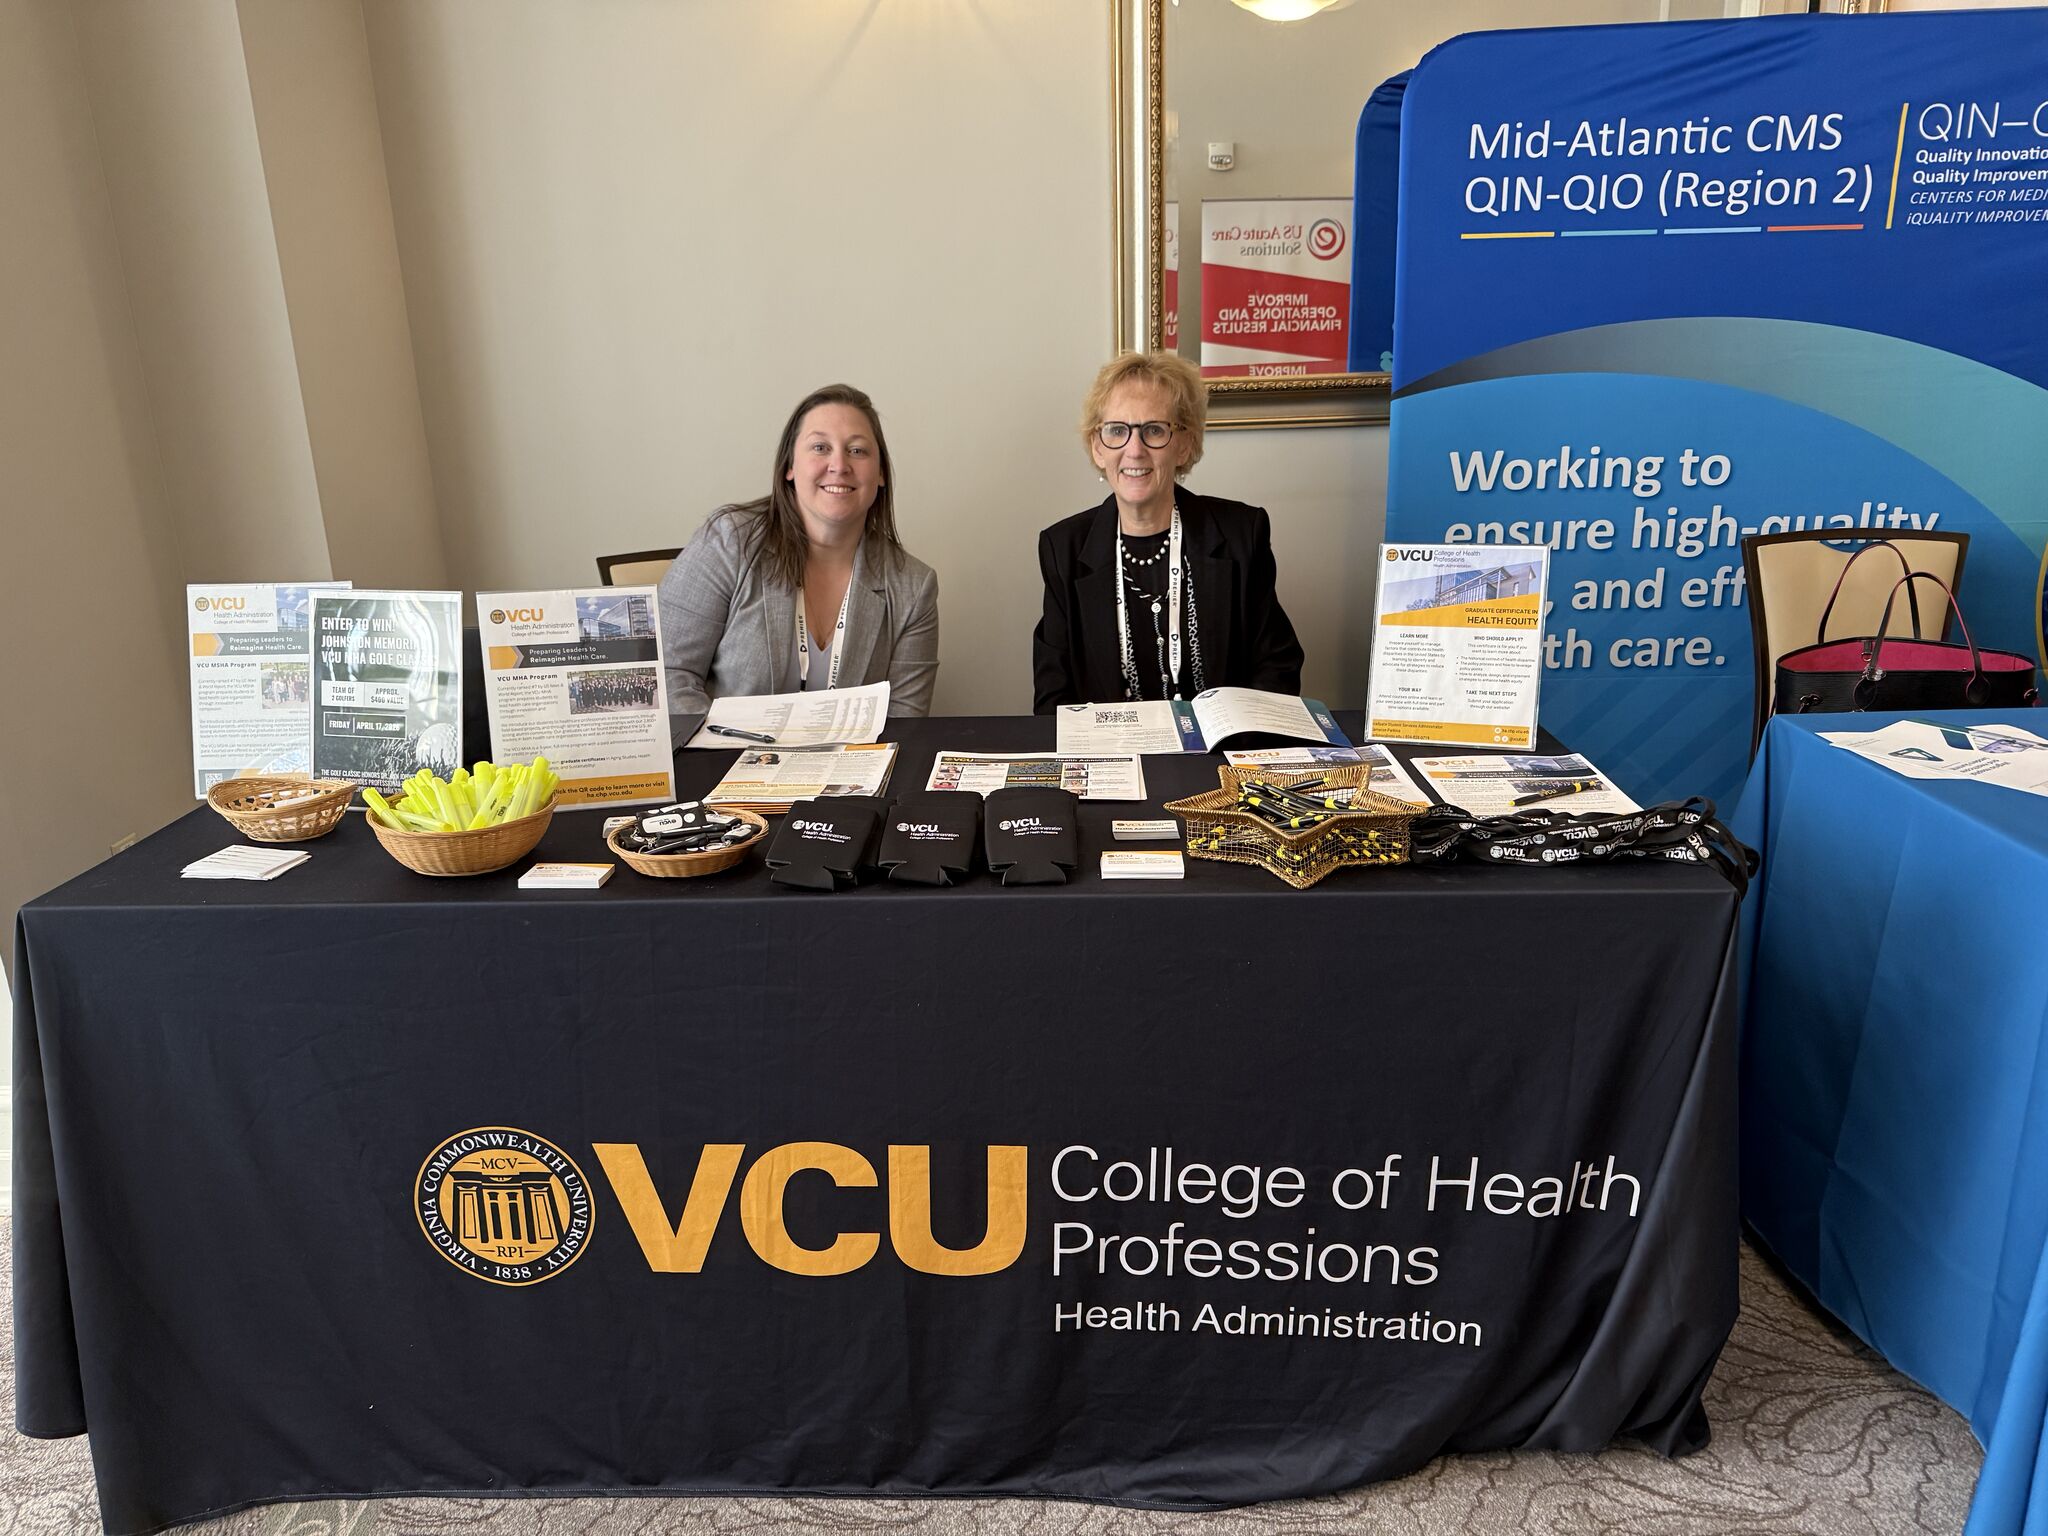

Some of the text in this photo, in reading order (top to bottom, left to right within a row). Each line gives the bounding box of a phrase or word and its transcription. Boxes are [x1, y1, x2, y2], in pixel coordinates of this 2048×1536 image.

[1469, 113, 1844, 160] Mid-Atlantic CMS
[1915, 148, 1973, 165] Quality
[1913, 169, 1970, 185] Quality
[1464, 165, 1874, 218] QIN-QIO (Region 2)
[1910, 191, 1974, 204] CENTERS
[1977, 190, 2006, 202] FOR
[1906, 212, 1973, 226] iQUALITY
[1449, 446, 1732, 498] Working to
[1444, 518, 1615, 551] ensure
[1400, 549, 1433, 562] VCU
[1572, 567, 1666, 611] and
[210, 597, 245, 610] VCU
[214, 611, 274, 619] Health Administration
[506, 608, 544, 622] VCU
[1467, 616, 1538, 626] HEALTH EQUITY
[321, 617, 395, 632] ENTER TO WIN!
[511, 622, 575, 631] Health Administration
[229, 636, 259, 645] Preparing
[1610, 632, 1725, 667] care.
[321, 651, 341, 664] VCU
[369, 652, 394, 666] GOLF
[530, 656, 566, 664] Reimagine
[831, 655, 839, 684] PREMIER
[332, 686, 346, 694] TEAM
[376, 688, 399, 696] APPROX.
[329, 720, 350, 729] FRIDAY
[356, 721, 375, 730] APRIL
[805, 821, 833, 833] VCU.
[909, 824, 939, 833] VCU.
[1011, 817, 1041, 828] VCU.
[1503, 847, 1525, 858] VCU.
[1555, 848, 1580, 858] VCU.
[480, 1158, 518, 1170] MCV
[1051, 1144, 1642, 1218] College of Health
[423, 1133, 588, 1269] VIRGINIA COMMONWEALTH UNIVERSITY
[592, 1141, 1029, 1277] VCU
[496, 1246, 524, 1258] RPI
[1052, 1222, 1439, 1286] Professions
[494, 1265, 532, 1280] 1838
[1054, 1301, 1482, 1347] Health Administration
